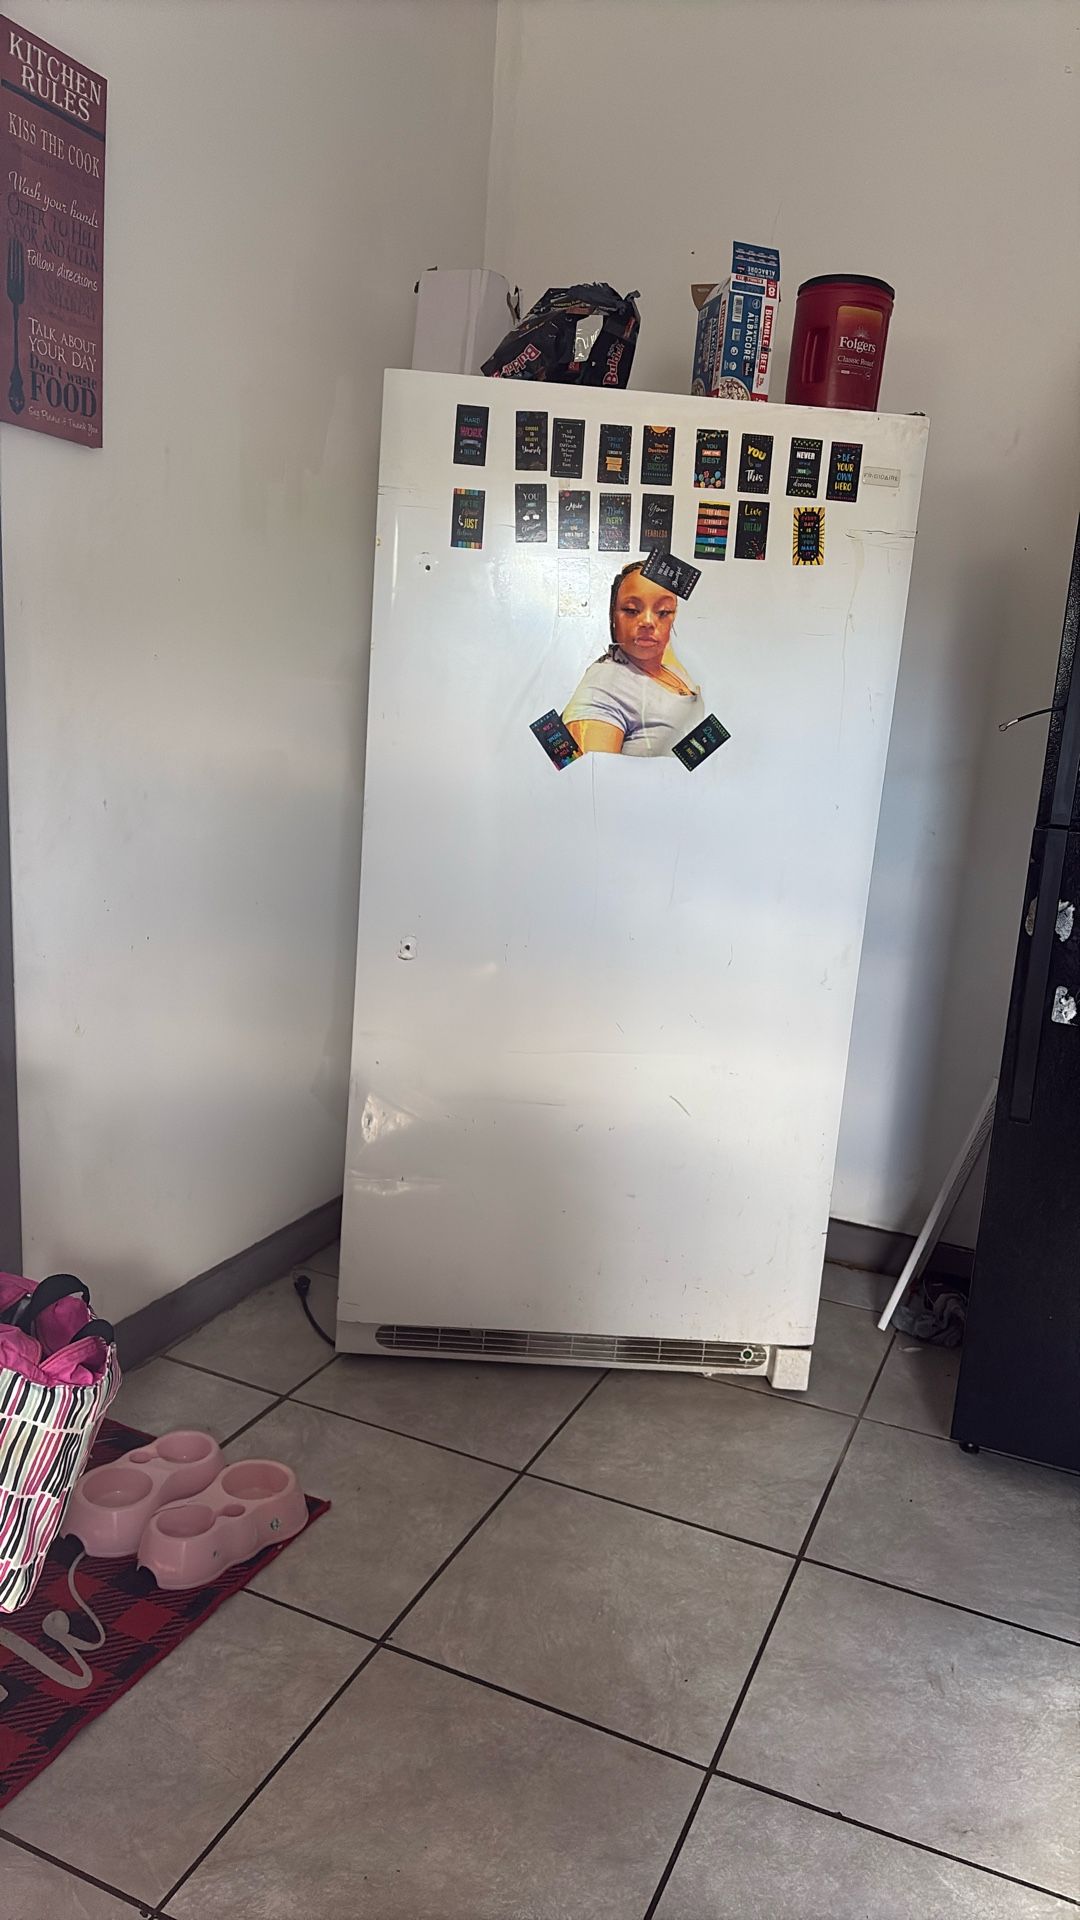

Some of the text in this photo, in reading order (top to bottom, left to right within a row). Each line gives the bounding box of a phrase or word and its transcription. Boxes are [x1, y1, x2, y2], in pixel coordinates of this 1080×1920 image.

[9, 31, 101, 106] KITCHEN
[21, 65, 90, 121] RULES
[8, 111, 100, 179] KISS THE COOK
[8, 170, 99, 228] Wash your hands
[27, 250, 97, 292] Follow directions
[768, 286, 776, 297] 8
[743, 311, 755, 361] ALBACORE
[762, 308, 773, 347] BUMBLE
[60, 332, 97, 355] ABOUT
[839, 336, 876, 353] Folgers
[29, 335, 97, 373] YOUR DAY
[759, 352, 768, 371] BEE
[837, 355, 861, 365] Classic
[29, 370, 97, 418] FOOD
[701, 456, 721, 464] BEST
[747, 444, 767, 461] YOU
[796, 451, 816, 460] NEVER
[842, 453, 851, 462] BE
[744, 468, 764, 482] This
[836, 463, 855, 472] YOUR
[836, 472, 853, 481] OWN
[834, 482, 852, 492] HERO
[522, 492, 541, 501] YOU
[744, 503, 763, 517] Live
[463, 518, 479, 530] JUST
